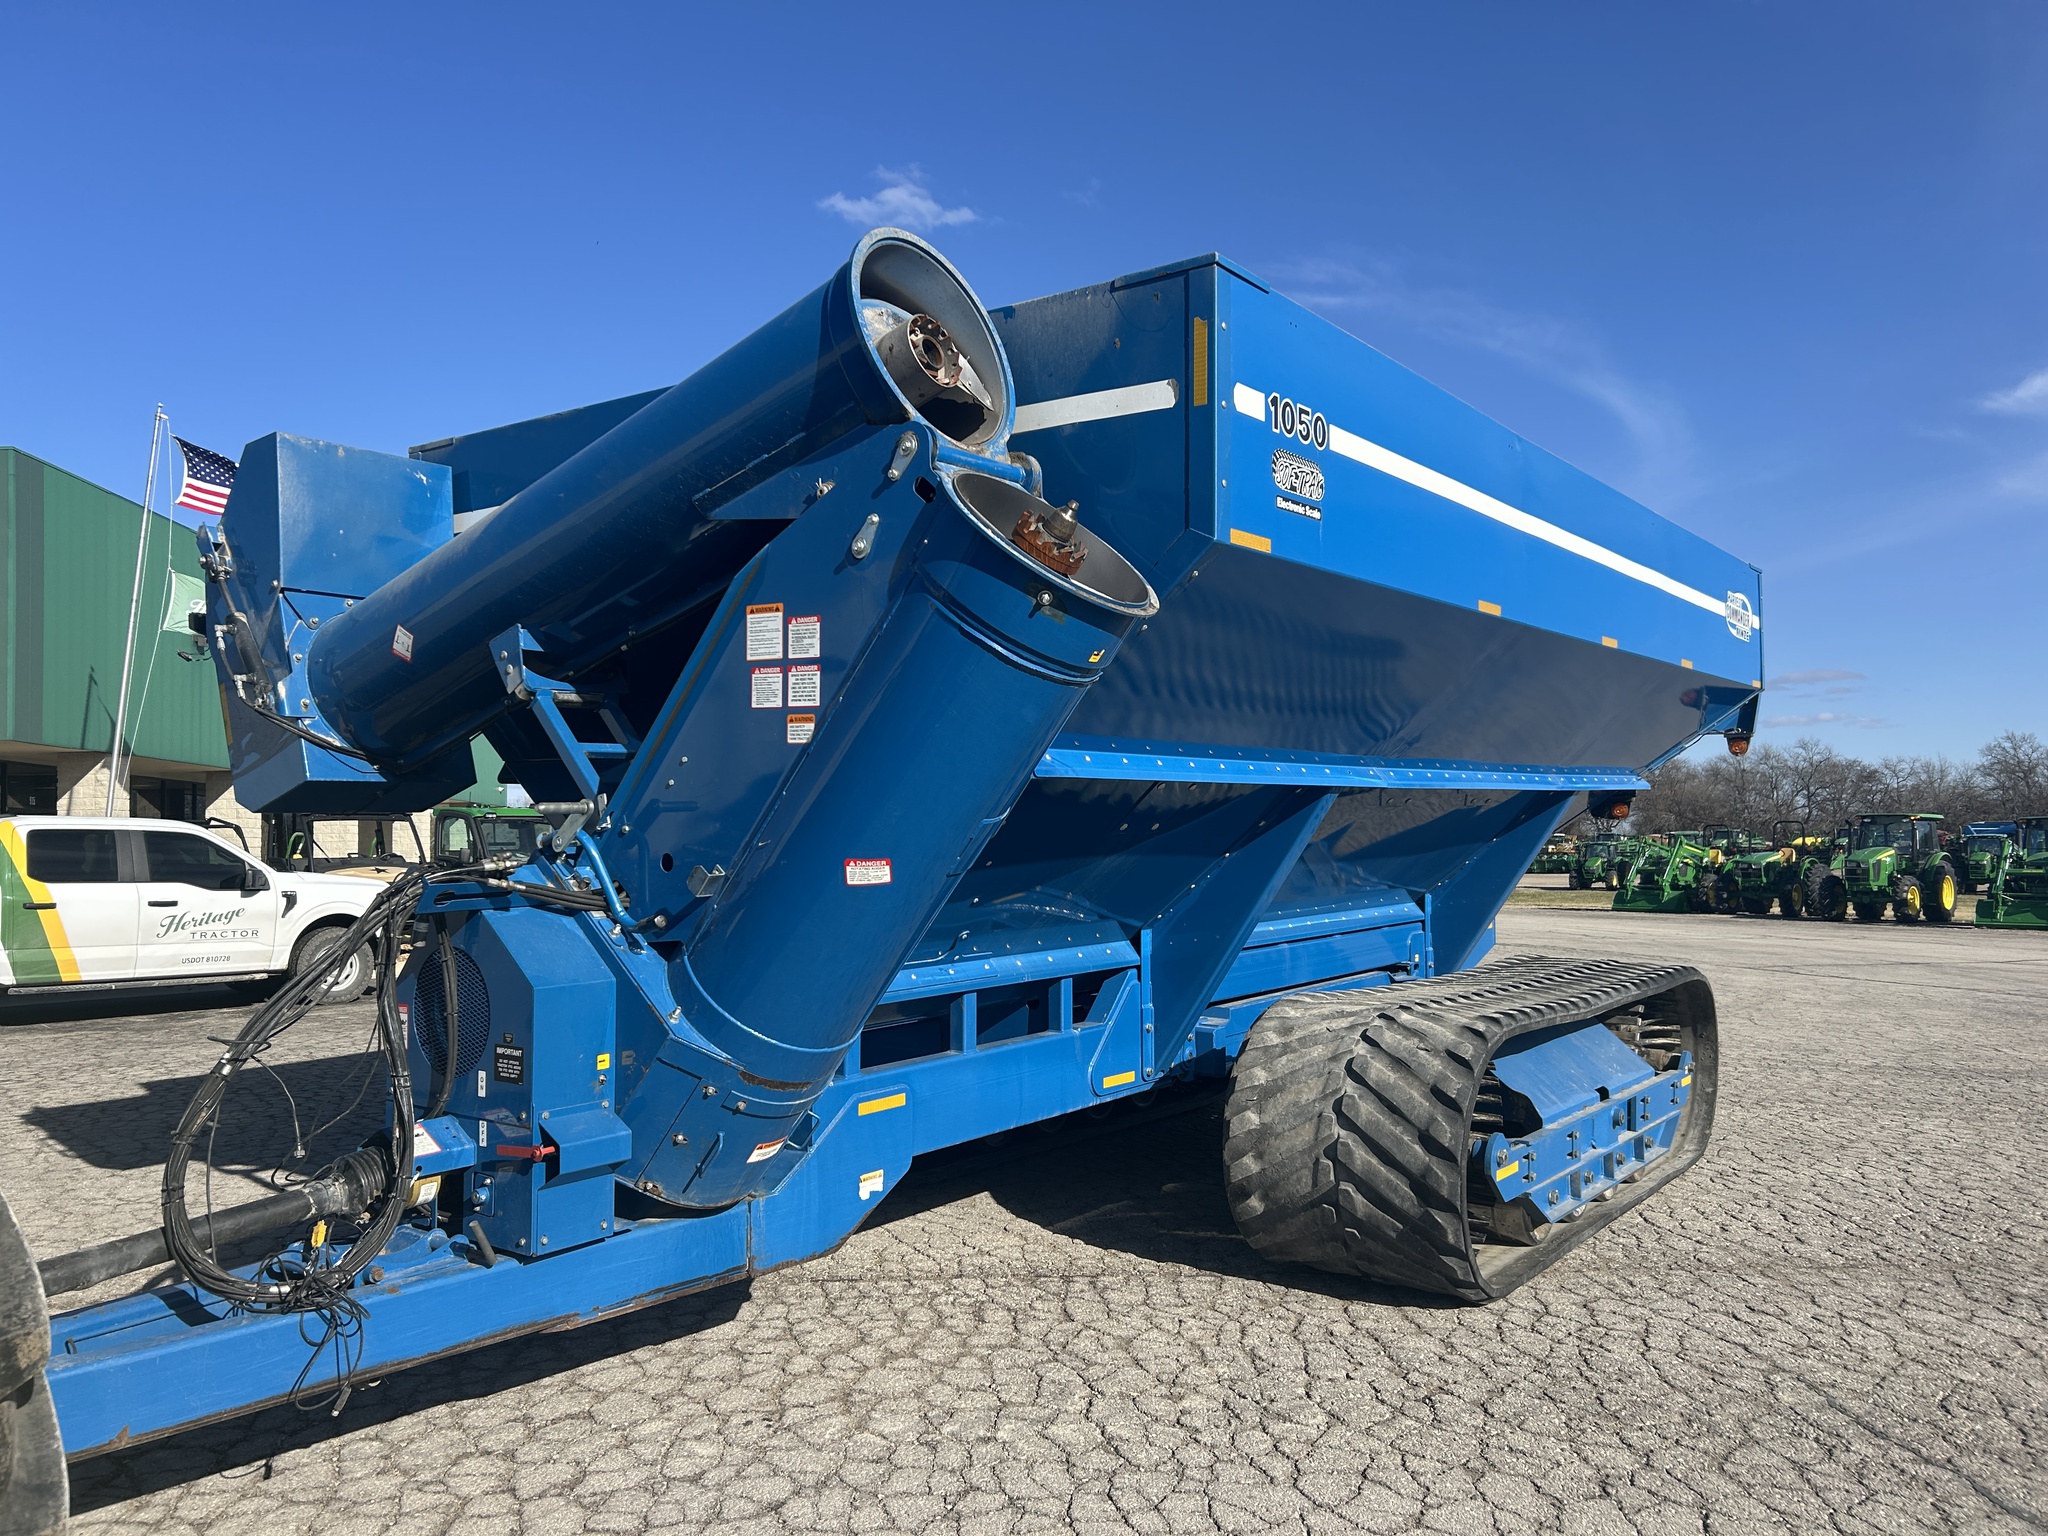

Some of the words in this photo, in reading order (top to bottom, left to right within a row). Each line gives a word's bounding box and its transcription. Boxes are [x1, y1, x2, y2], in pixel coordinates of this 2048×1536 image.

[1268, 392, 1327, 450] 1050
[1276, 497, 1305, 515] Electronic
[1305, 505, 1321, 520] Scale
[797, 616, 818, 624] DANGER
[156, 907, 246, 939] Heritage
[190, 929, 260, 940] TRACTOR
[181, 956, 205, 964] USDOT
[205, 955, 231, 963] 810728
[496, 1047, 523, 1057] IMPORTANT
